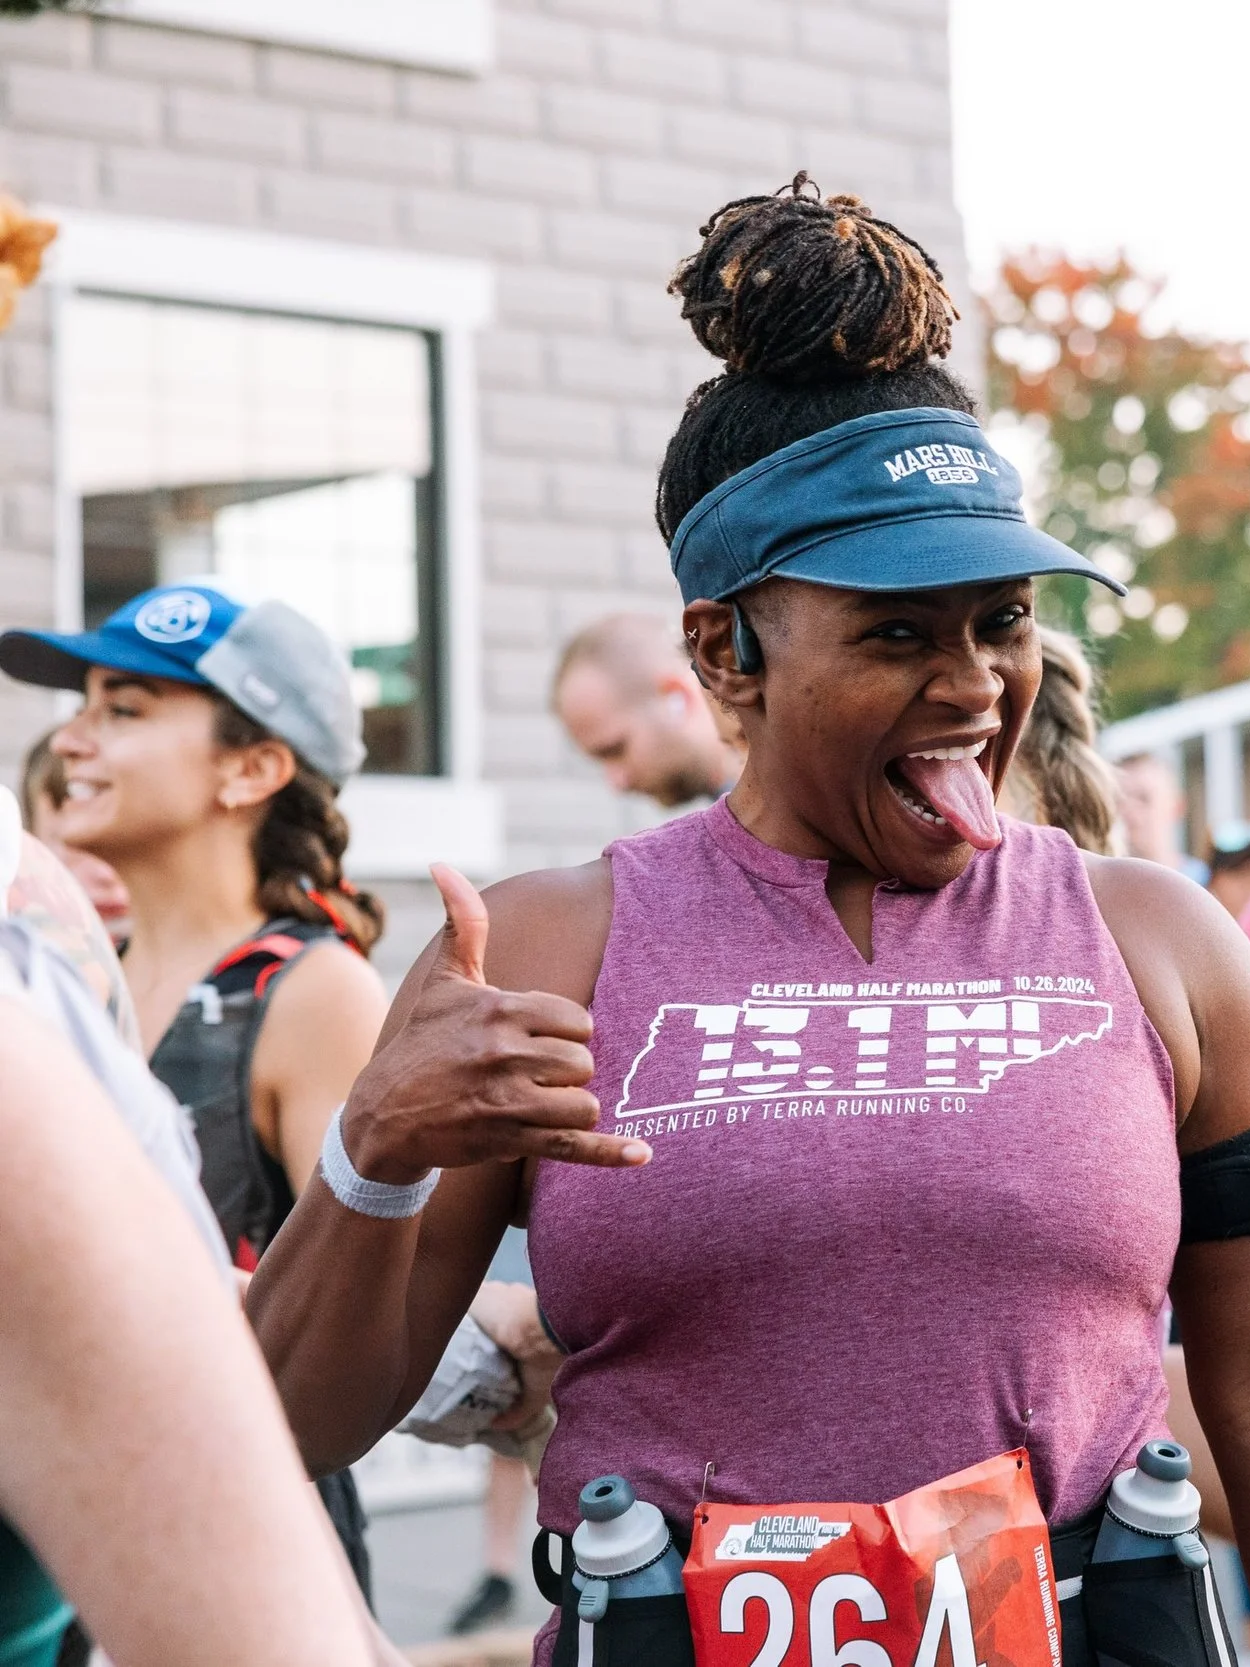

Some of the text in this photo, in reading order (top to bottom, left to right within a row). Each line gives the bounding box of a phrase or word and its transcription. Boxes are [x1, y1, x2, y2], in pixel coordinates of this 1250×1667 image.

[884, 444, 999, 482] MARS HILL
[751, 976, 1095, 997] CLEVELAND HALF MARATHON 10.26.2024
[694, 1002, 1042, 1098] 13.1 MI
[614, 1096, 974, 1139] PRESENTED BY TERRA RUNNING CO.
[750, 1535, 771, 1549] HALF
[772, 1534, 817, 1549] MARATHON
[759, 1516, 819, 1534] CLEVELAND
[1034, 1543, 1048, 1579] TERRA
[720, 1553, 987, 1667] 264
[1040, 1579, 1056, 1628] RUNNING
